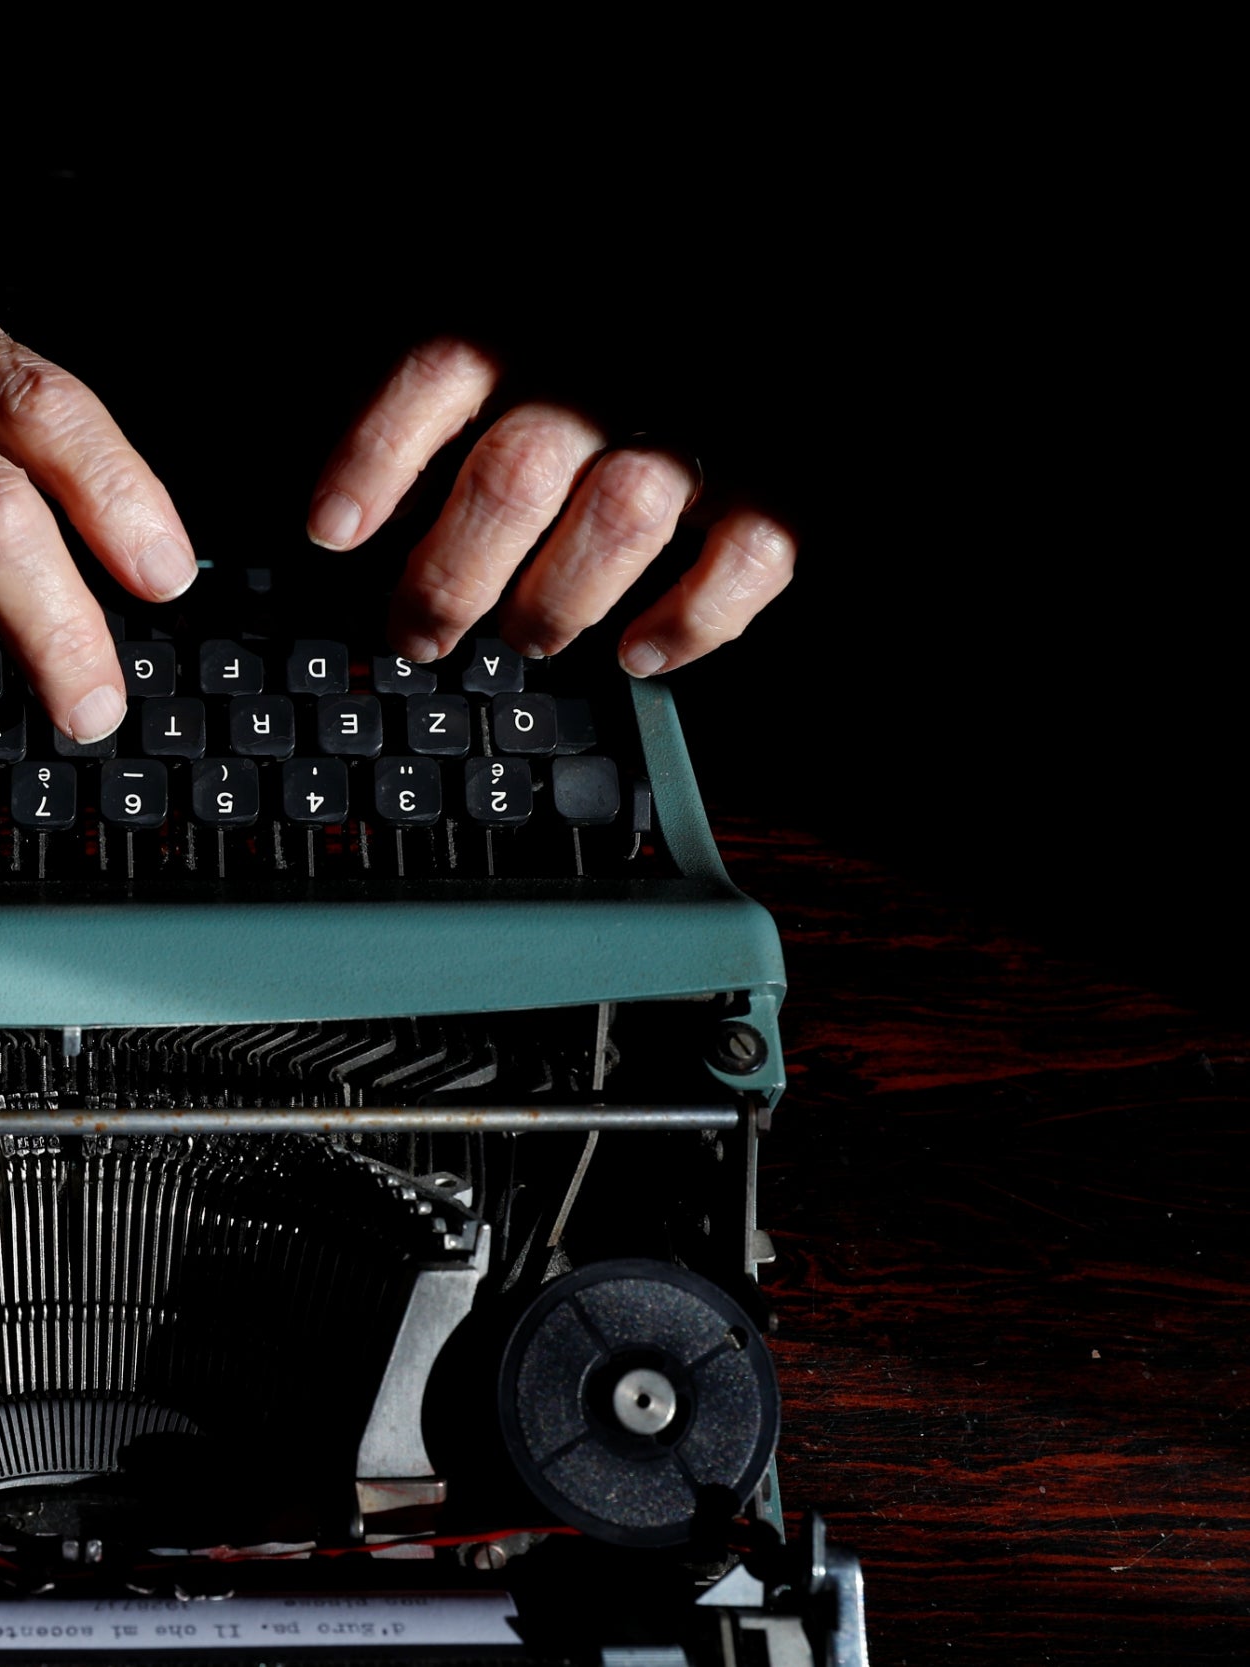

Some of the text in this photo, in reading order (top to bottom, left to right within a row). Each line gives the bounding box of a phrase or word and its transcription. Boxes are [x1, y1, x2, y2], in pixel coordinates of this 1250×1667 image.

[134, 658, 154, 680] G
[222, 658, 240, 679] F
[307, 657, 327, 679] D
[395, 656, 412, 677] S
[482, 655, 501, 677] A
[163, 715, 183, 737] T
[251, 713, 271, 735] R
[339, 713, 359, 735] E
[428, 712, 447, 734] Z
[512, 708, 535, 733] Q
[37, 767, 51, 789] è
[491, 762, 505, 785] é
[34, 795, 52, 817] 7
[124, 793, 142, 815] 6
[216, 791, 234, 814] 5
[305, 791, 325, 814] 4
[398, 789, 417, 812] 3
[490, 791, 508, 813] 2
[110, 1625, 138, 1640] mi
